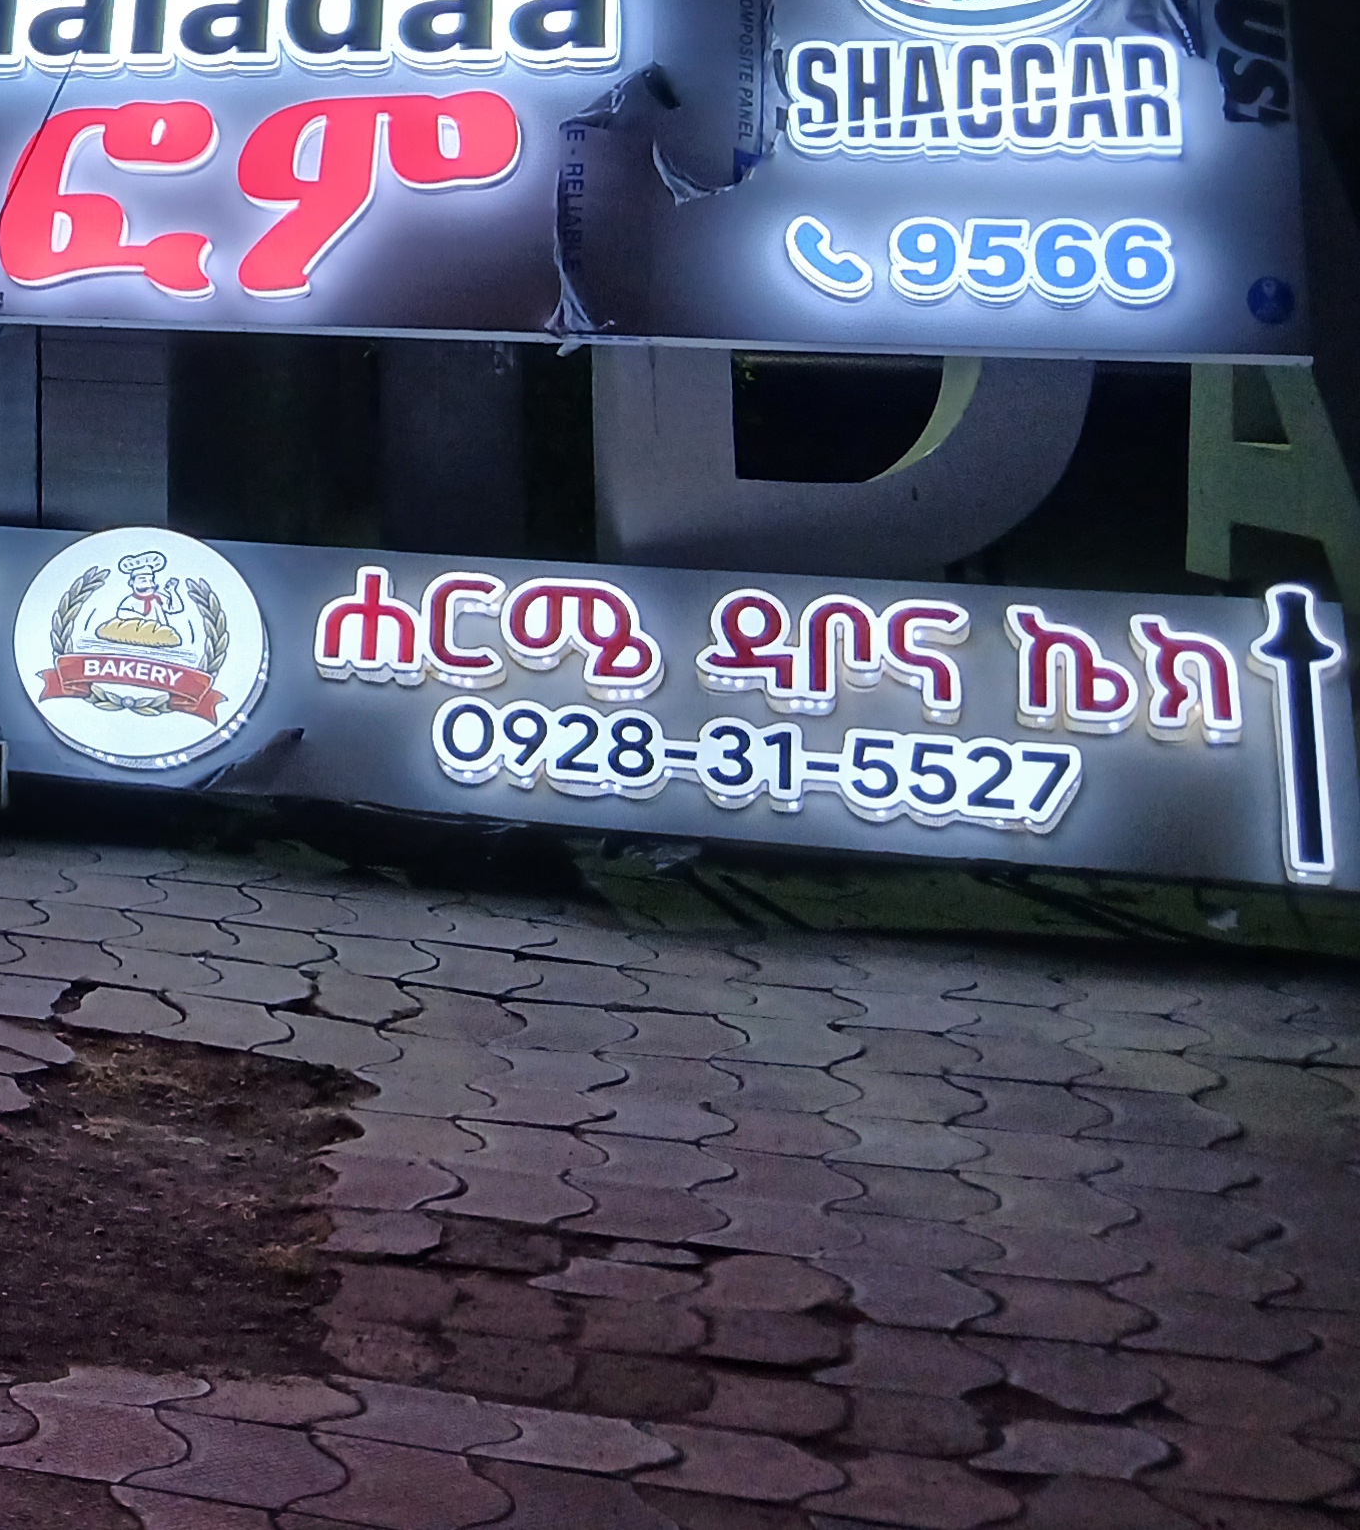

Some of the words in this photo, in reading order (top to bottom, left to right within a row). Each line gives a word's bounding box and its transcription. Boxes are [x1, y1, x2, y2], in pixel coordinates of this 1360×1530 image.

[738, 86, 754, 141] PANEL
[894, 220, 1169, 292] 9566
[84, 659, 183, 687] BAKERY
[440, 705, 1075, 811] 0928-31-5527
